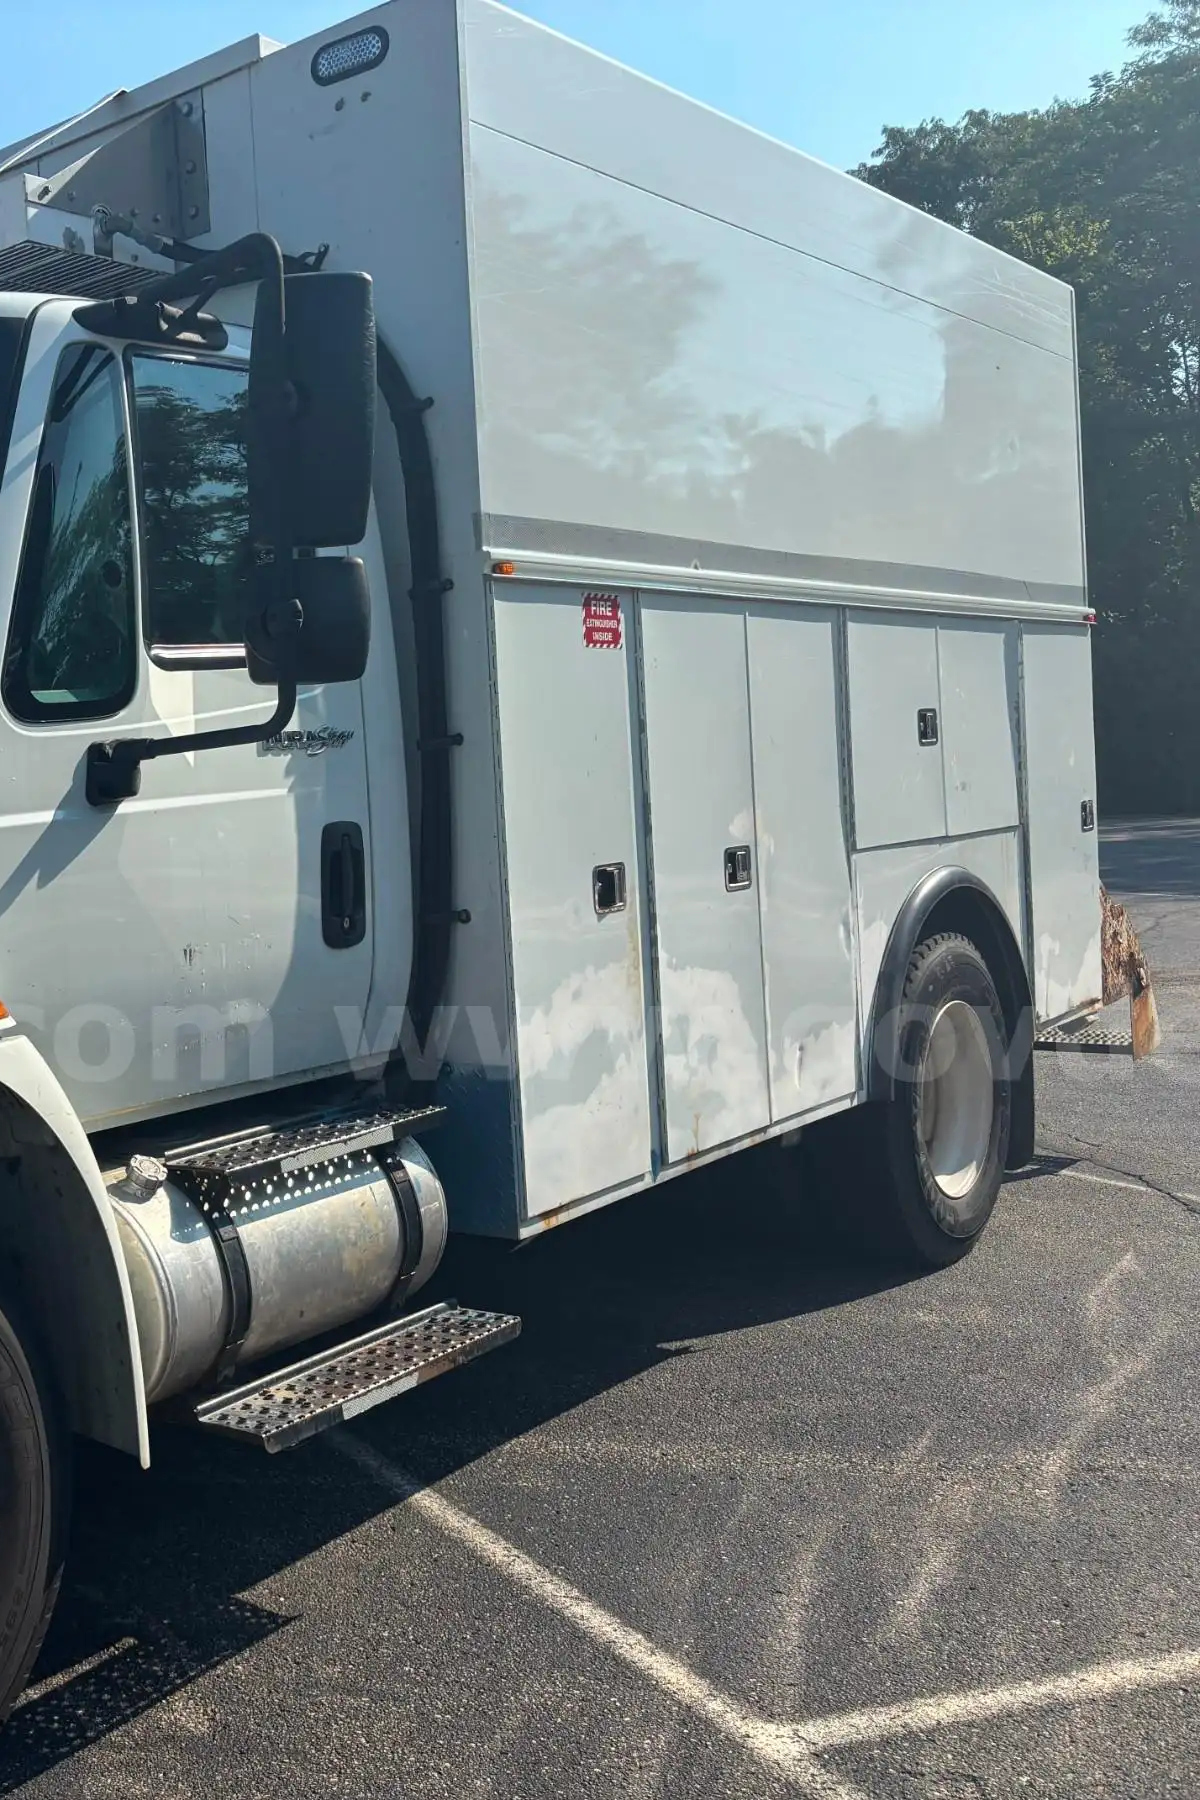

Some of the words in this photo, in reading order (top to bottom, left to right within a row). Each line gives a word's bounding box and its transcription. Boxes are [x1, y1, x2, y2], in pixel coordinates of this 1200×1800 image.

[591, 600, 612, 616] FIRE
[586, 618, 617, 629] EXTINGUISHER
[592, 631, 613, 641] INSIDE
